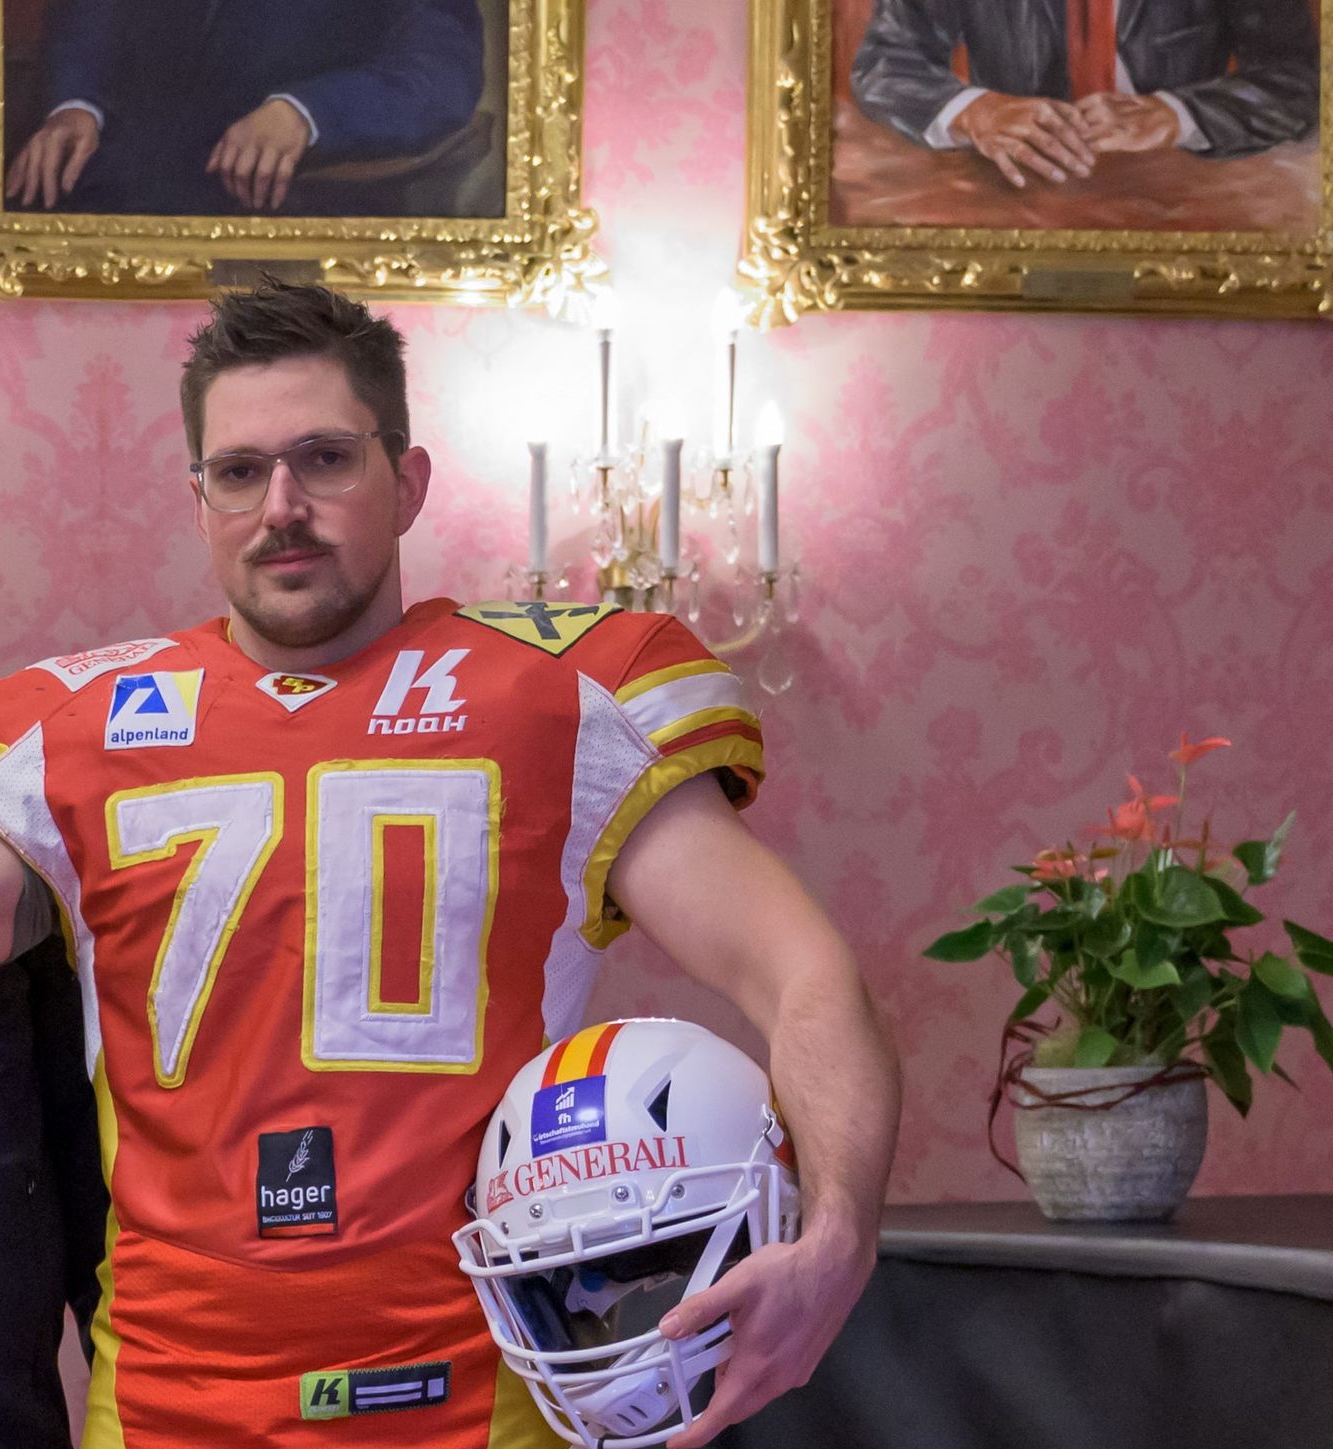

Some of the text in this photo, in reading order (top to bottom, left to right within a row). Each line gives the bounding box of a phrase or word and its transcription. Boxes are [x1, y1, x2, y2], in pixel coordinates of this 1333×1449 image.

[110, 728, 188, 745] alpenland
[104, 758, 501, 1089] 70
[557, 1112, 572, 1125] fh
[513, 1136, 690, 1197] GENERALI
[260, 1185, 331, 1210] hager
